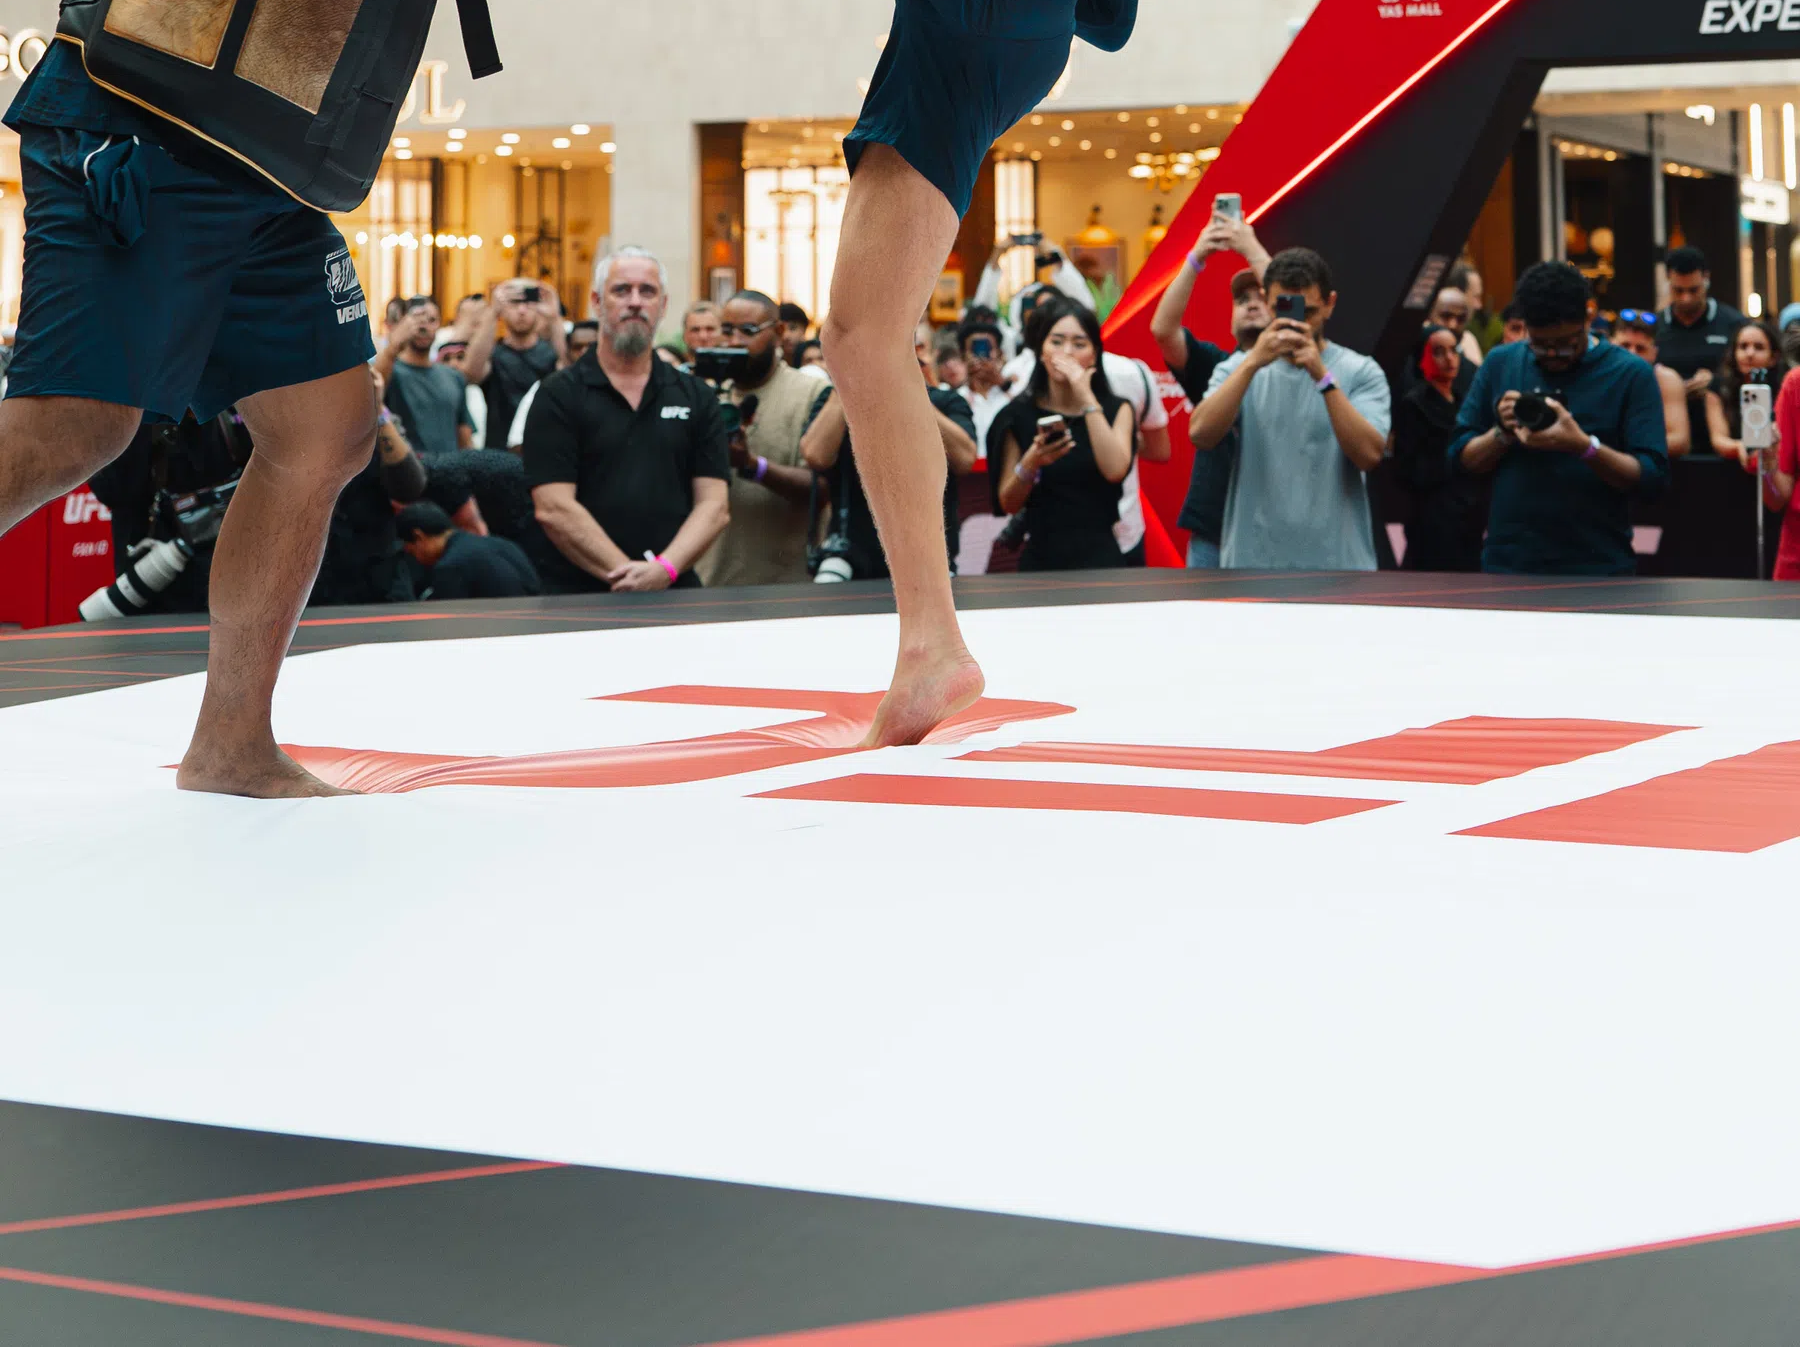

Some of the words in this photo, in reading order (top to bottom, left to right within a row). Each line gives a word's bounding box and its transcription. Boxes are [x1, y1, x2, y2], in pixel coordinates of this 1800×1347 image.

[1378, 3, 1404, 19] YAS
[1405, 1, 1443, 17] MALL
[661, 406, 691, 420] UFC
